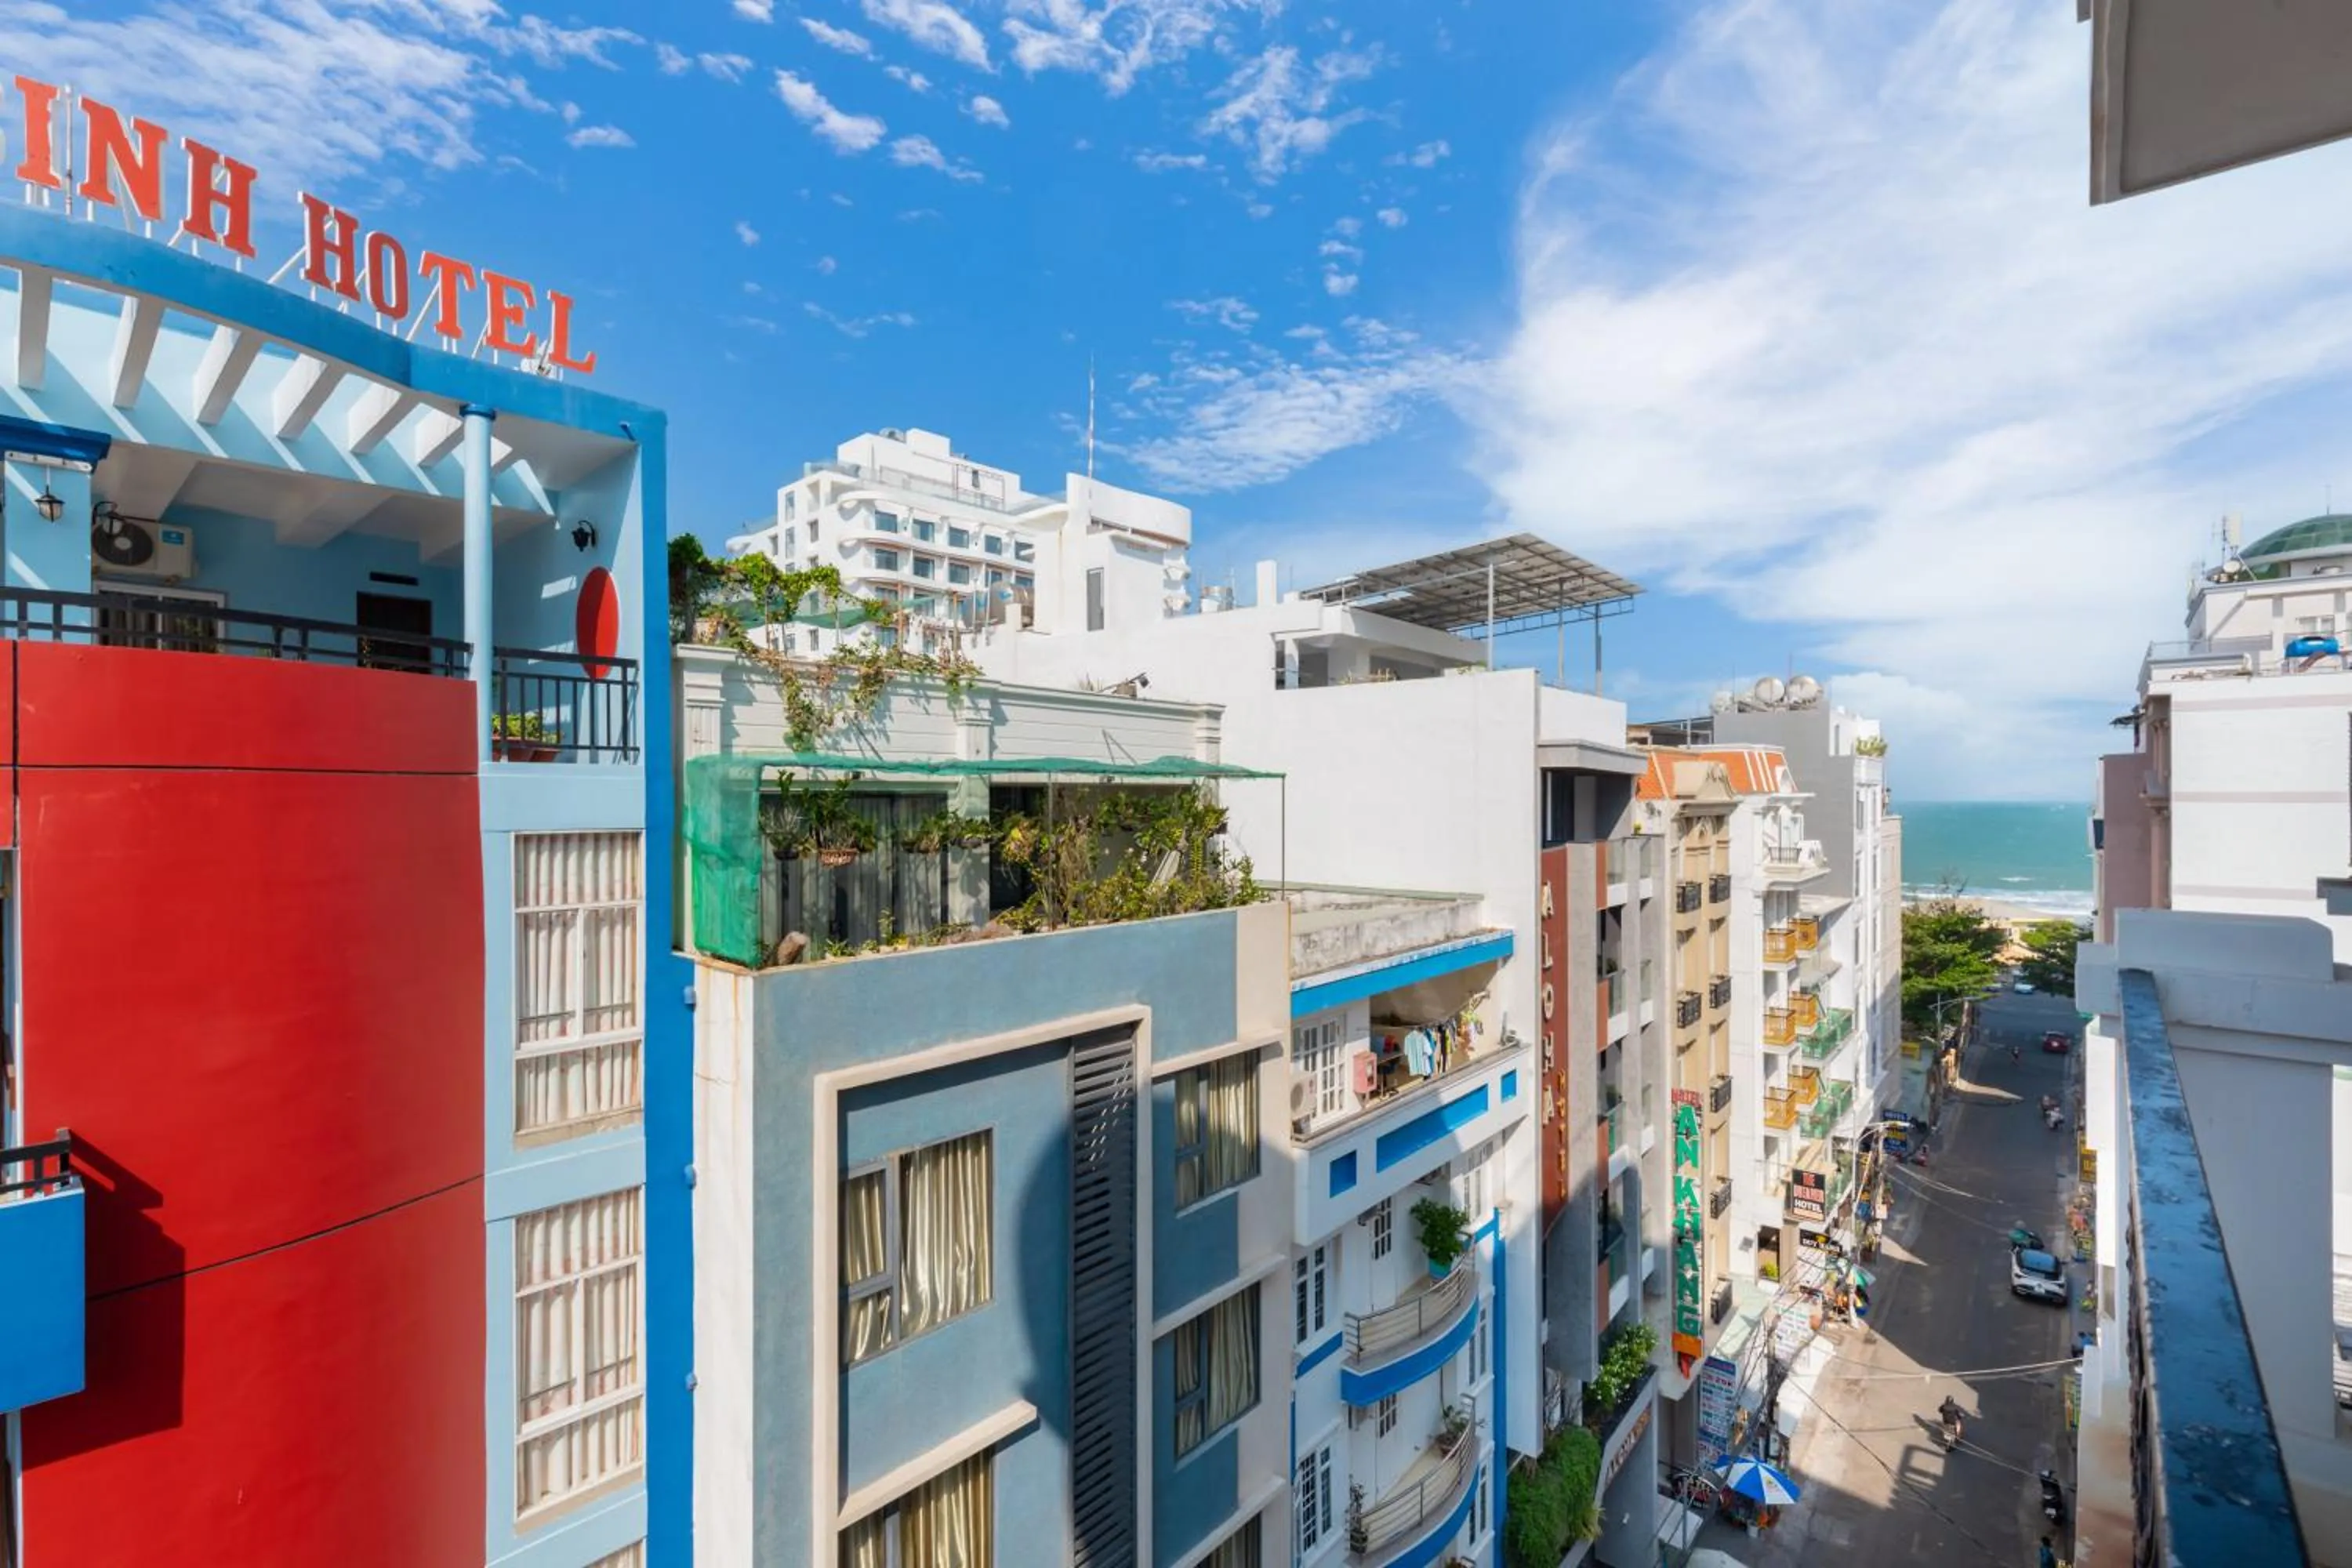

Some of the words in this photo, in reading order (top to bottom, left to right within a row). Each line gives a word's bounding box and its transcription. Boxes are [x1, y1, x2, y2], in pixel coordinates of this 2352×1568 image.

[0, 74, 258, 259] INH
[297, 191, 597, 374] HOTEL
[1541, 880, 1555, 1125] ALOHA
[1794, 1199, 1823, 1213] HOTEL
